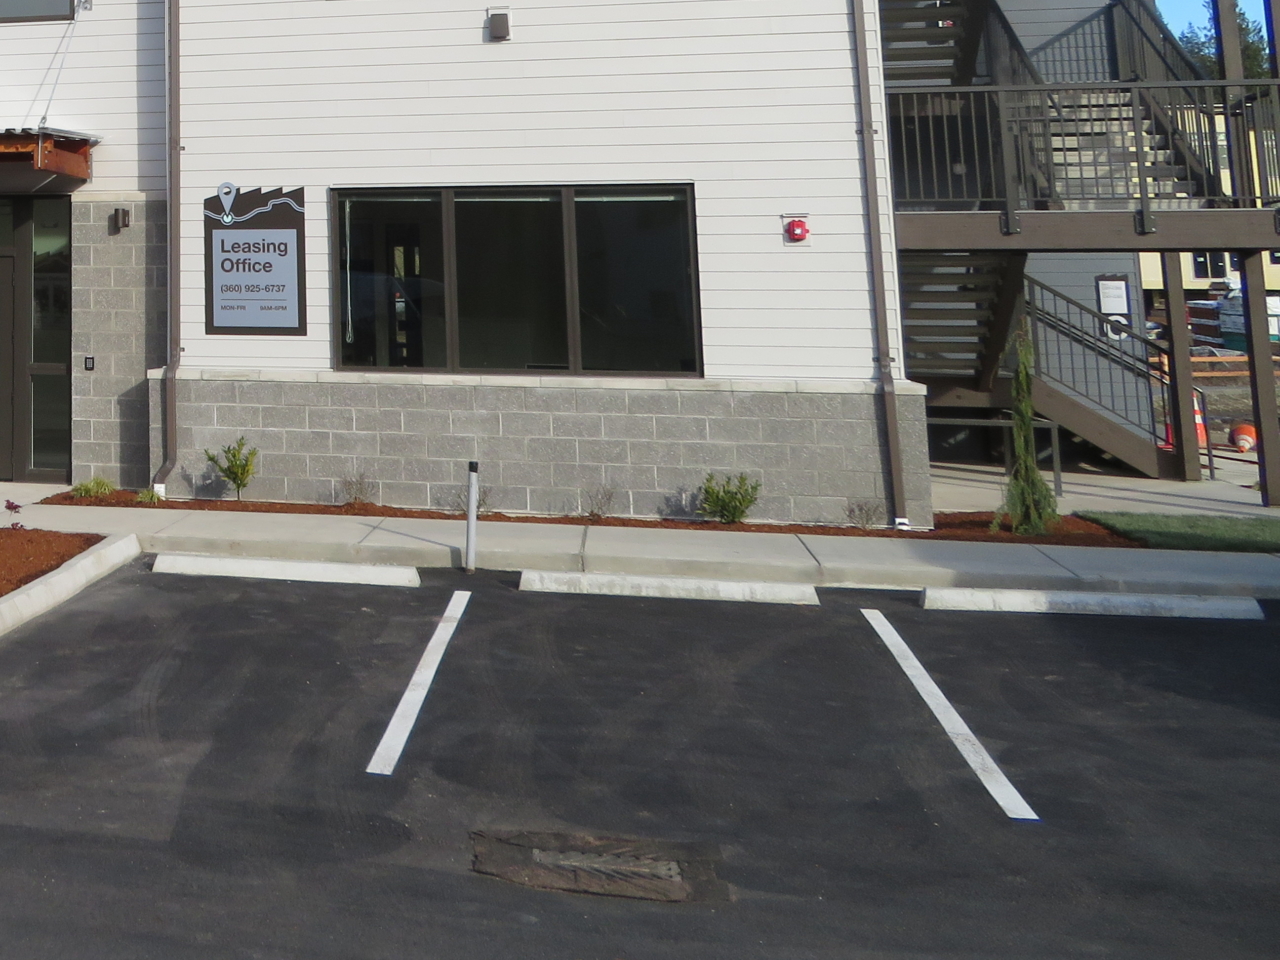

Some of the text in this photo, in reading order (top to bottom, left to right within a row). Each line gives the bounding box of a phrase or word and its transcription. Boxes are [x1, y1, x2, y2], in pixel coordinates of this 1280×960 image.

[220, 238, 288, 257] Leasing
[220, 257, 273, 273] Office
[220, 284, 286, 294] (360) 925-6737
